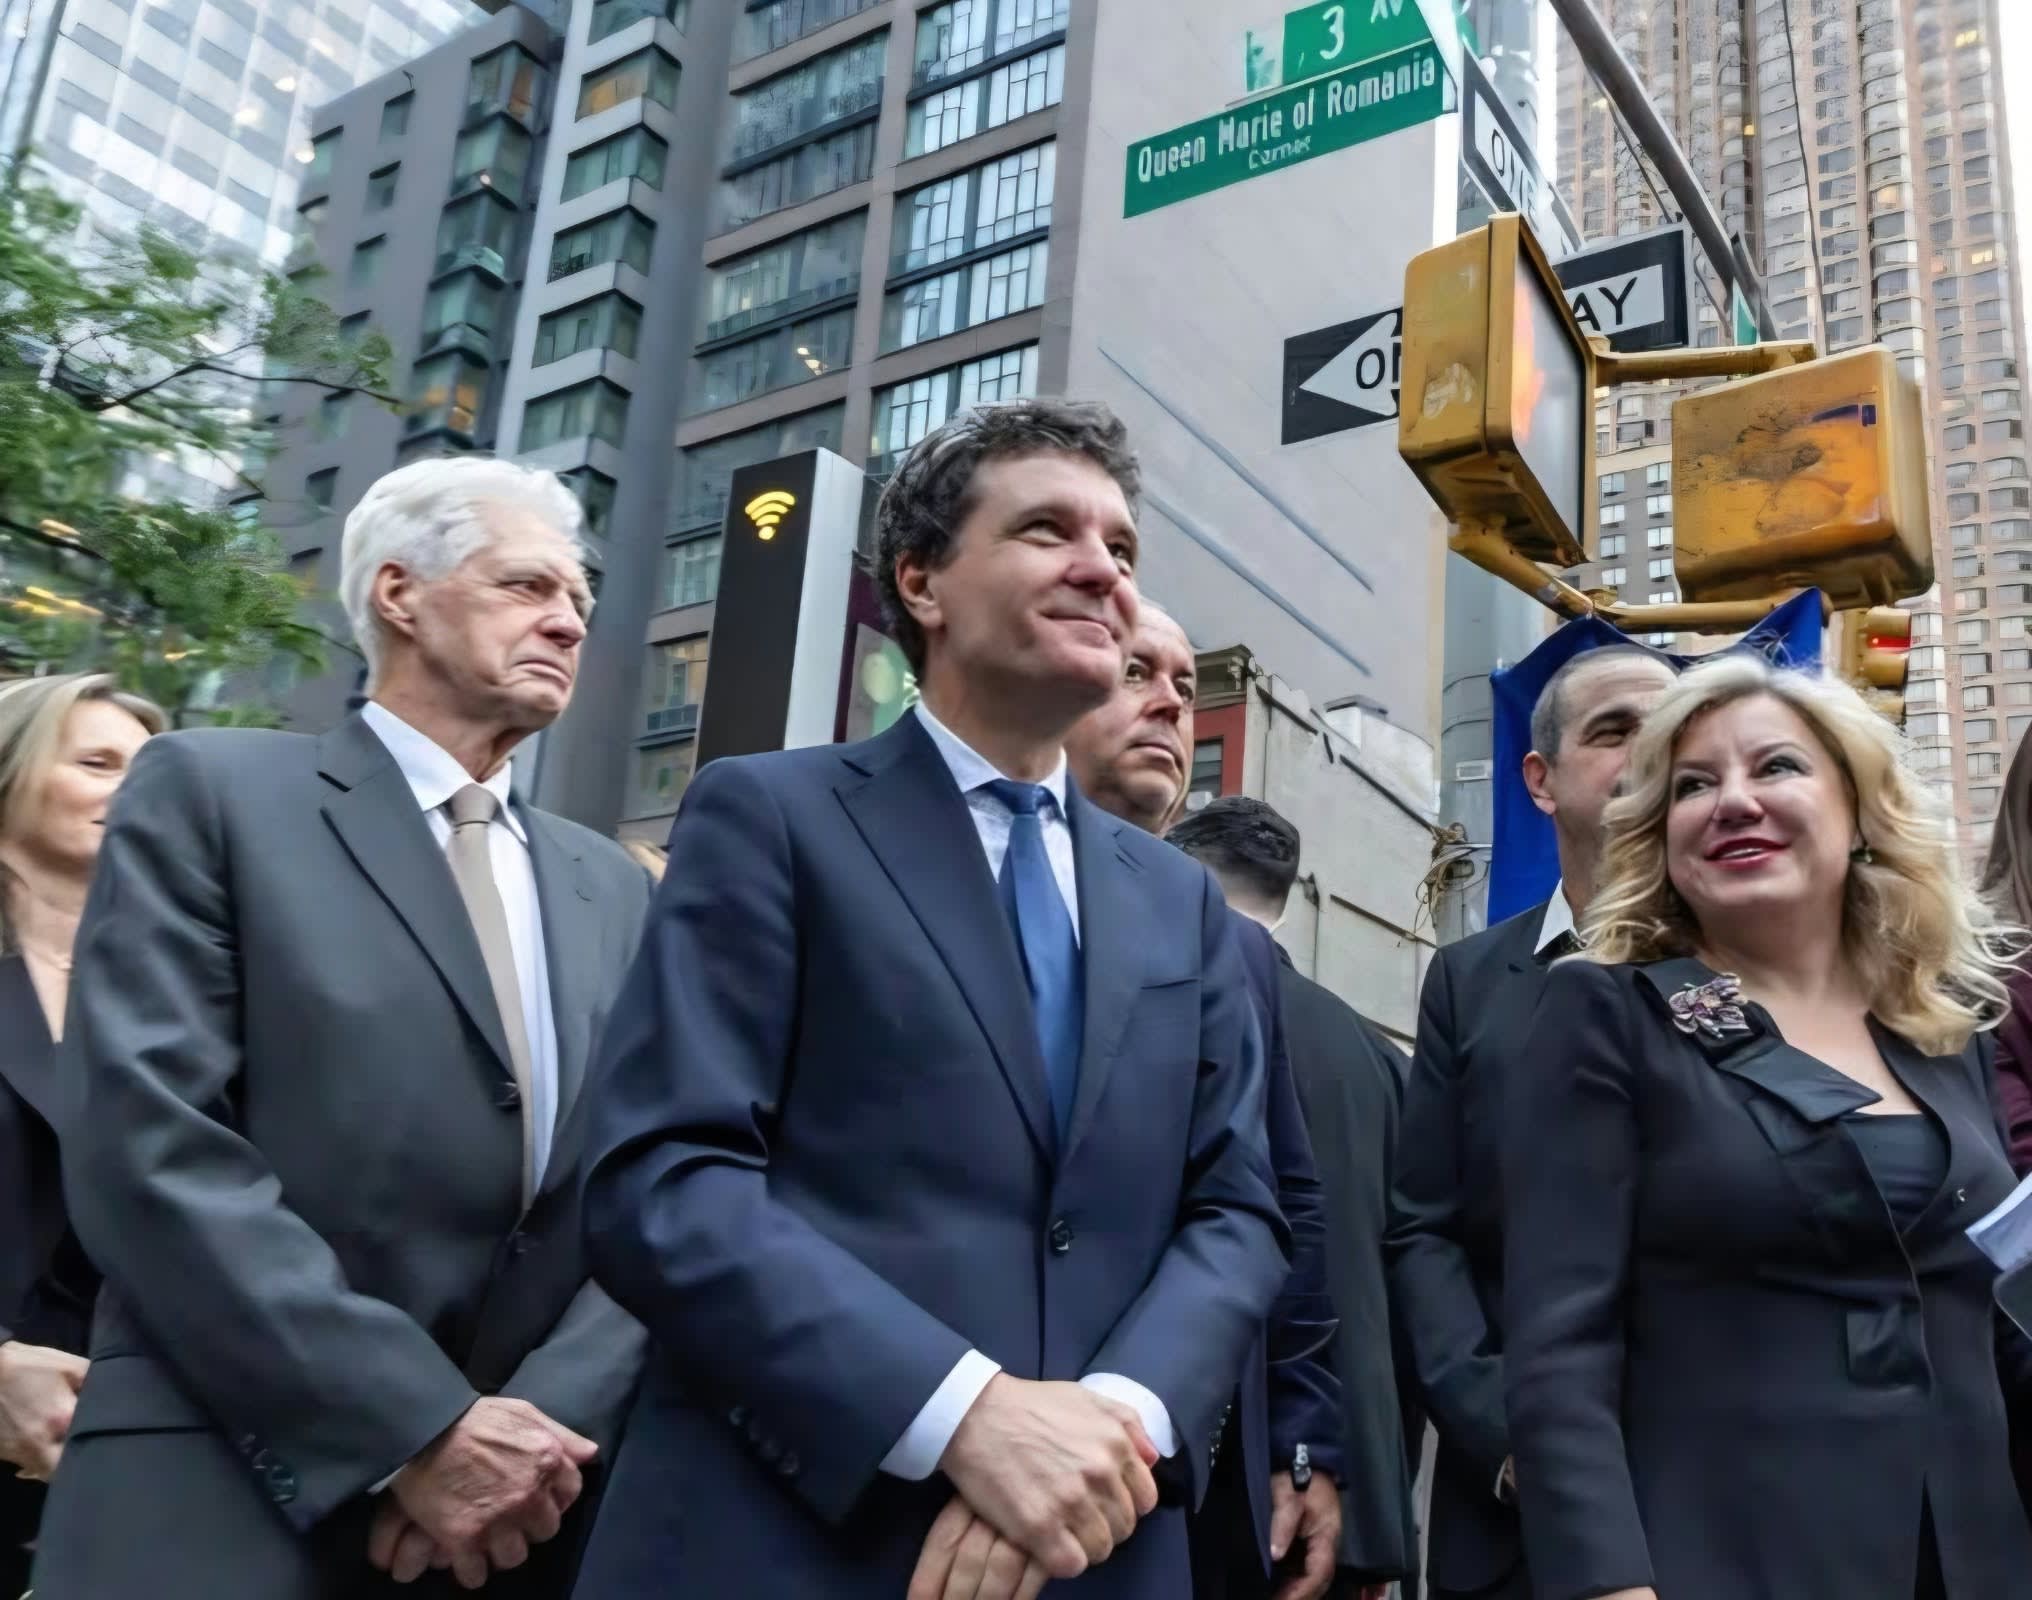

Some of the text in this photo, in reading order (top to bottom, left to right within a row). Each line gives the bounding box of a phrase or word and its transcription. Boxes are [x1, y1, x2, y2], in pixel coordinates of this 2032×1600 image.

[1320, 4, 1345, 60] 3
[1138, 136, 1206, 183] Queen
[1218, 103, 1282, 156] Marie
[1327, 51, 1435, 118] Romania
[1572, 277, 1638, 332] AY
